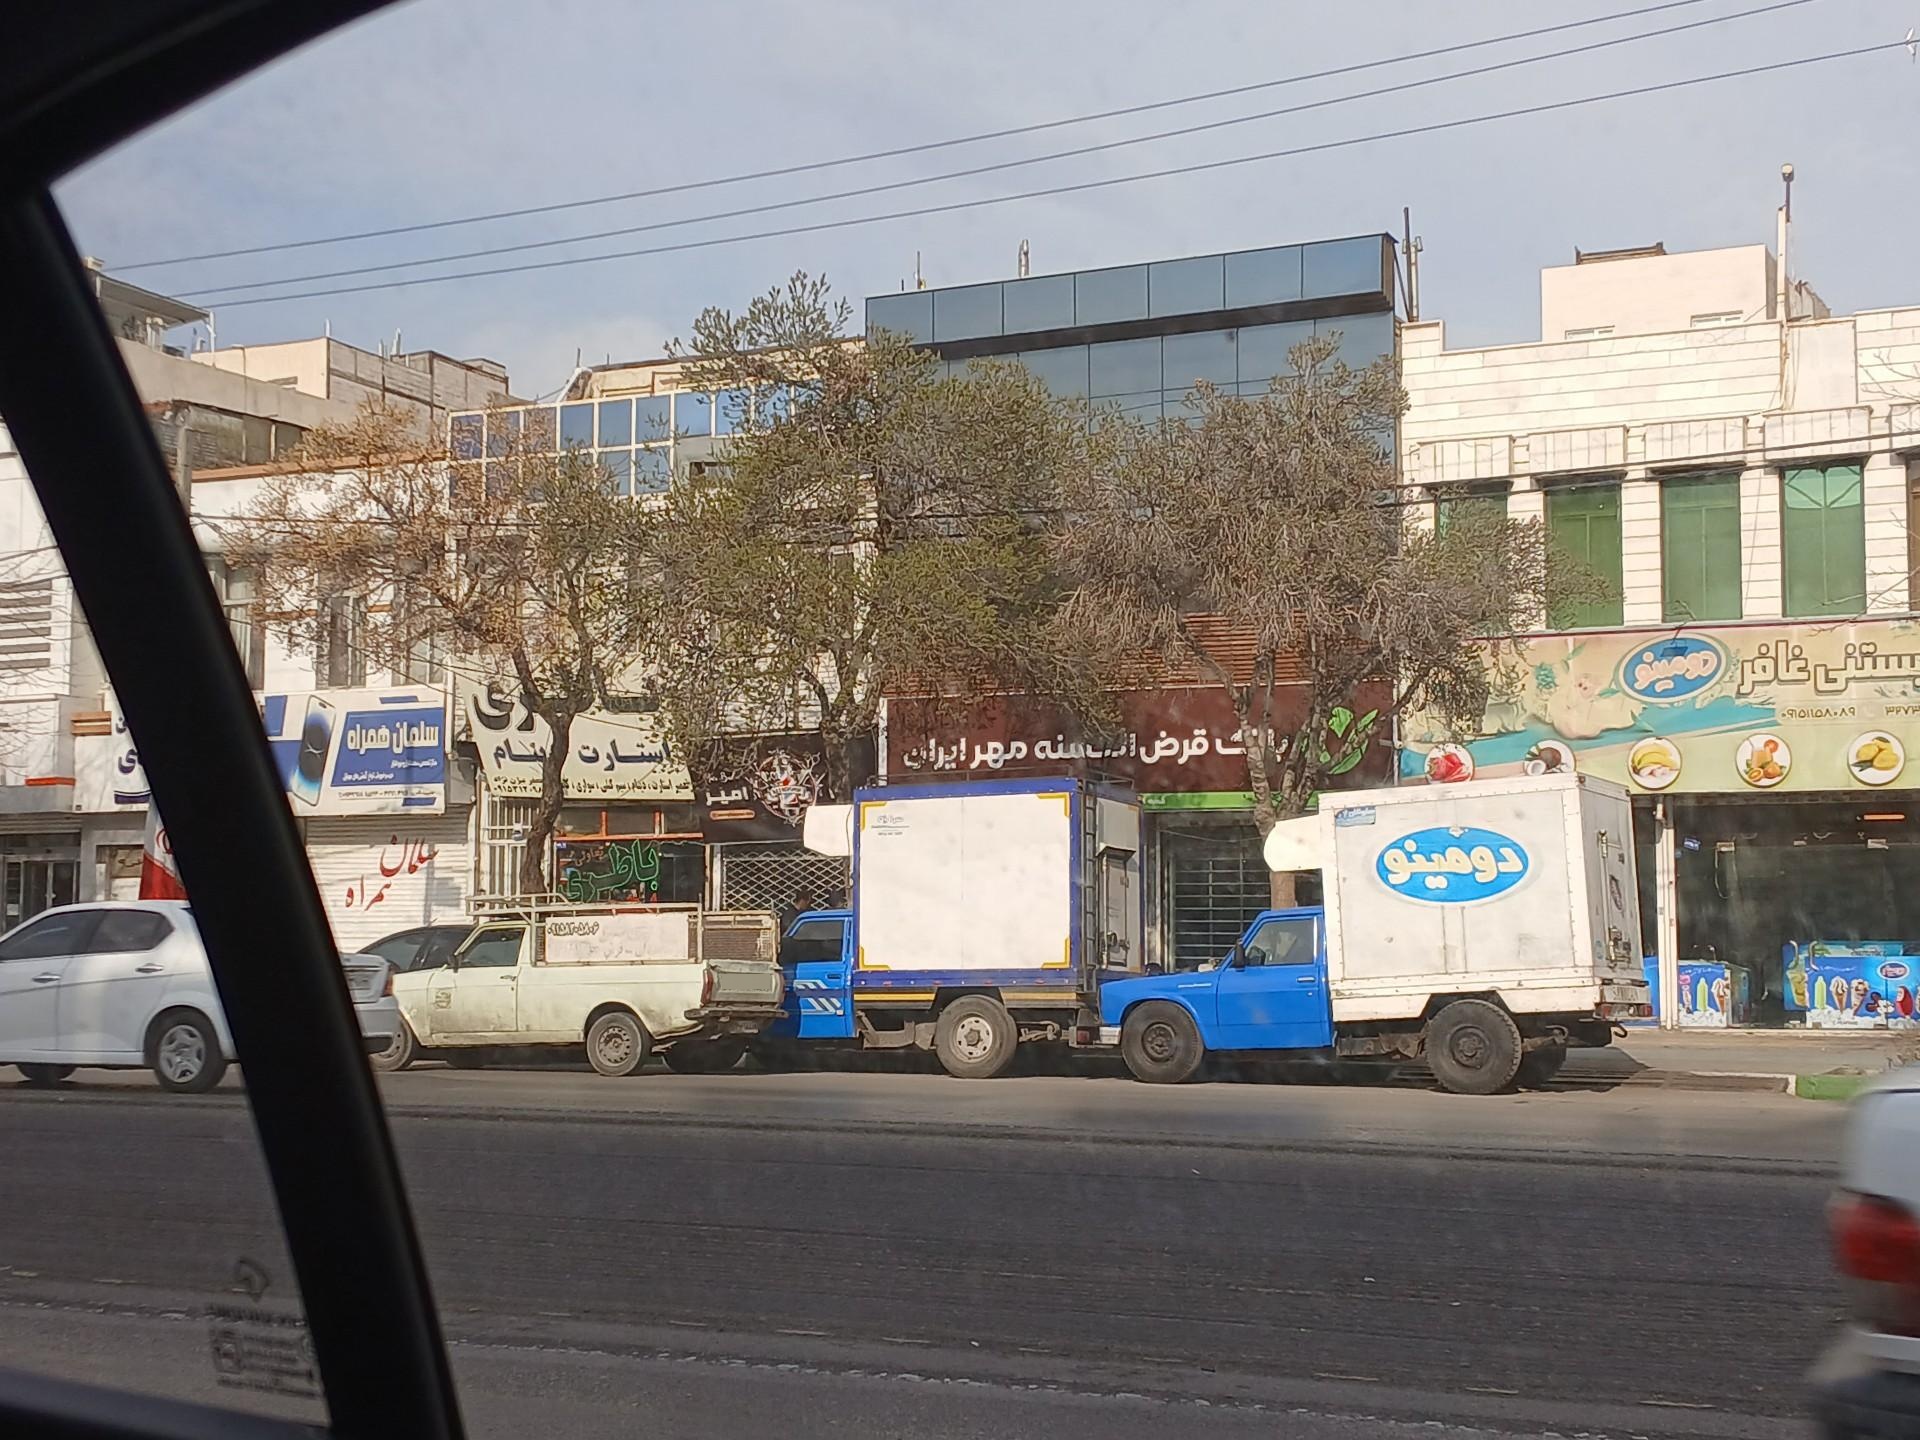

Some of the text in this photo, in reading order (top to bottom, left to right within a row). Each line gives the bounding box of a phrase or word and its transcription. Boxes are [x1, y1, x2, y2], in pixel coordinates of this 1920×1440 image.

[1634, 651, 1718, 693] دومینو
[1737, 640, 1811, 696] غافر
[347, 721, 439, 755] سلمان همراه
[969, 740, 1028, 769] مهر
[1139, 728, 1210, 765] قرض
[1215, 728, 1290, 763] باک
[706, 787, 749, 807] امیر
[1383, 839, 1524, 890] دومینو
